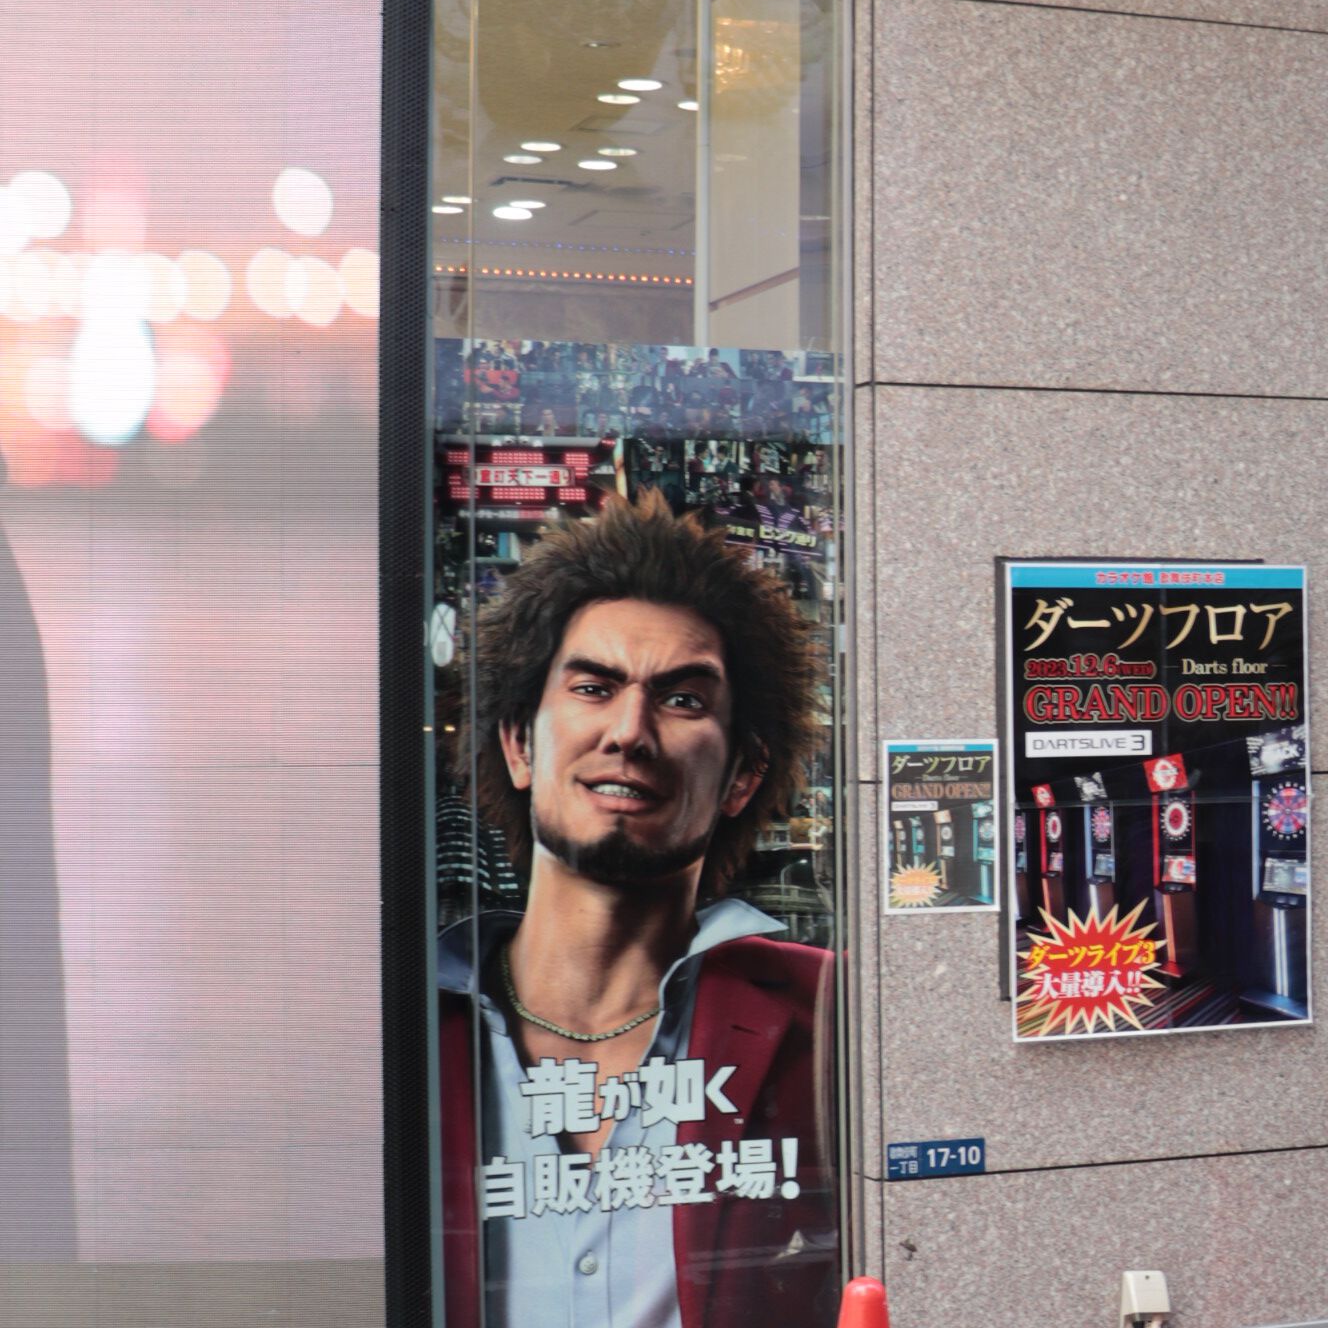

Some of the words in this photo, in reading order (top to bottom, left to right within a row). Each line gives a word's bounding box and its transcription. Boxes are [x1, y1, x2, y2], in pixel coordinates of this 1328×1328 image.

[1024, 597, 1294, 652] ダーツフロア
[1182, 658, 1228, 675] Darts
[1232, 657, 1269, 675] floor
[1025, 684, 1170, 723] GRAND
[1174, 683, 1298, 722] OPEN!!
[1130, 734, 1145, 752] 3
[891, 755, 992, 775] ダーツフロア
[1026, 940, 1156, 971] ダーツライブ3
[1034, 970, 1143, 1001] 大量導入!!
[520, 1056, 738, 1139] 龍が如く
[926, 1144, 982, 1169] 17-10
[481, 1137, 800, 1221] 自販機登場!
